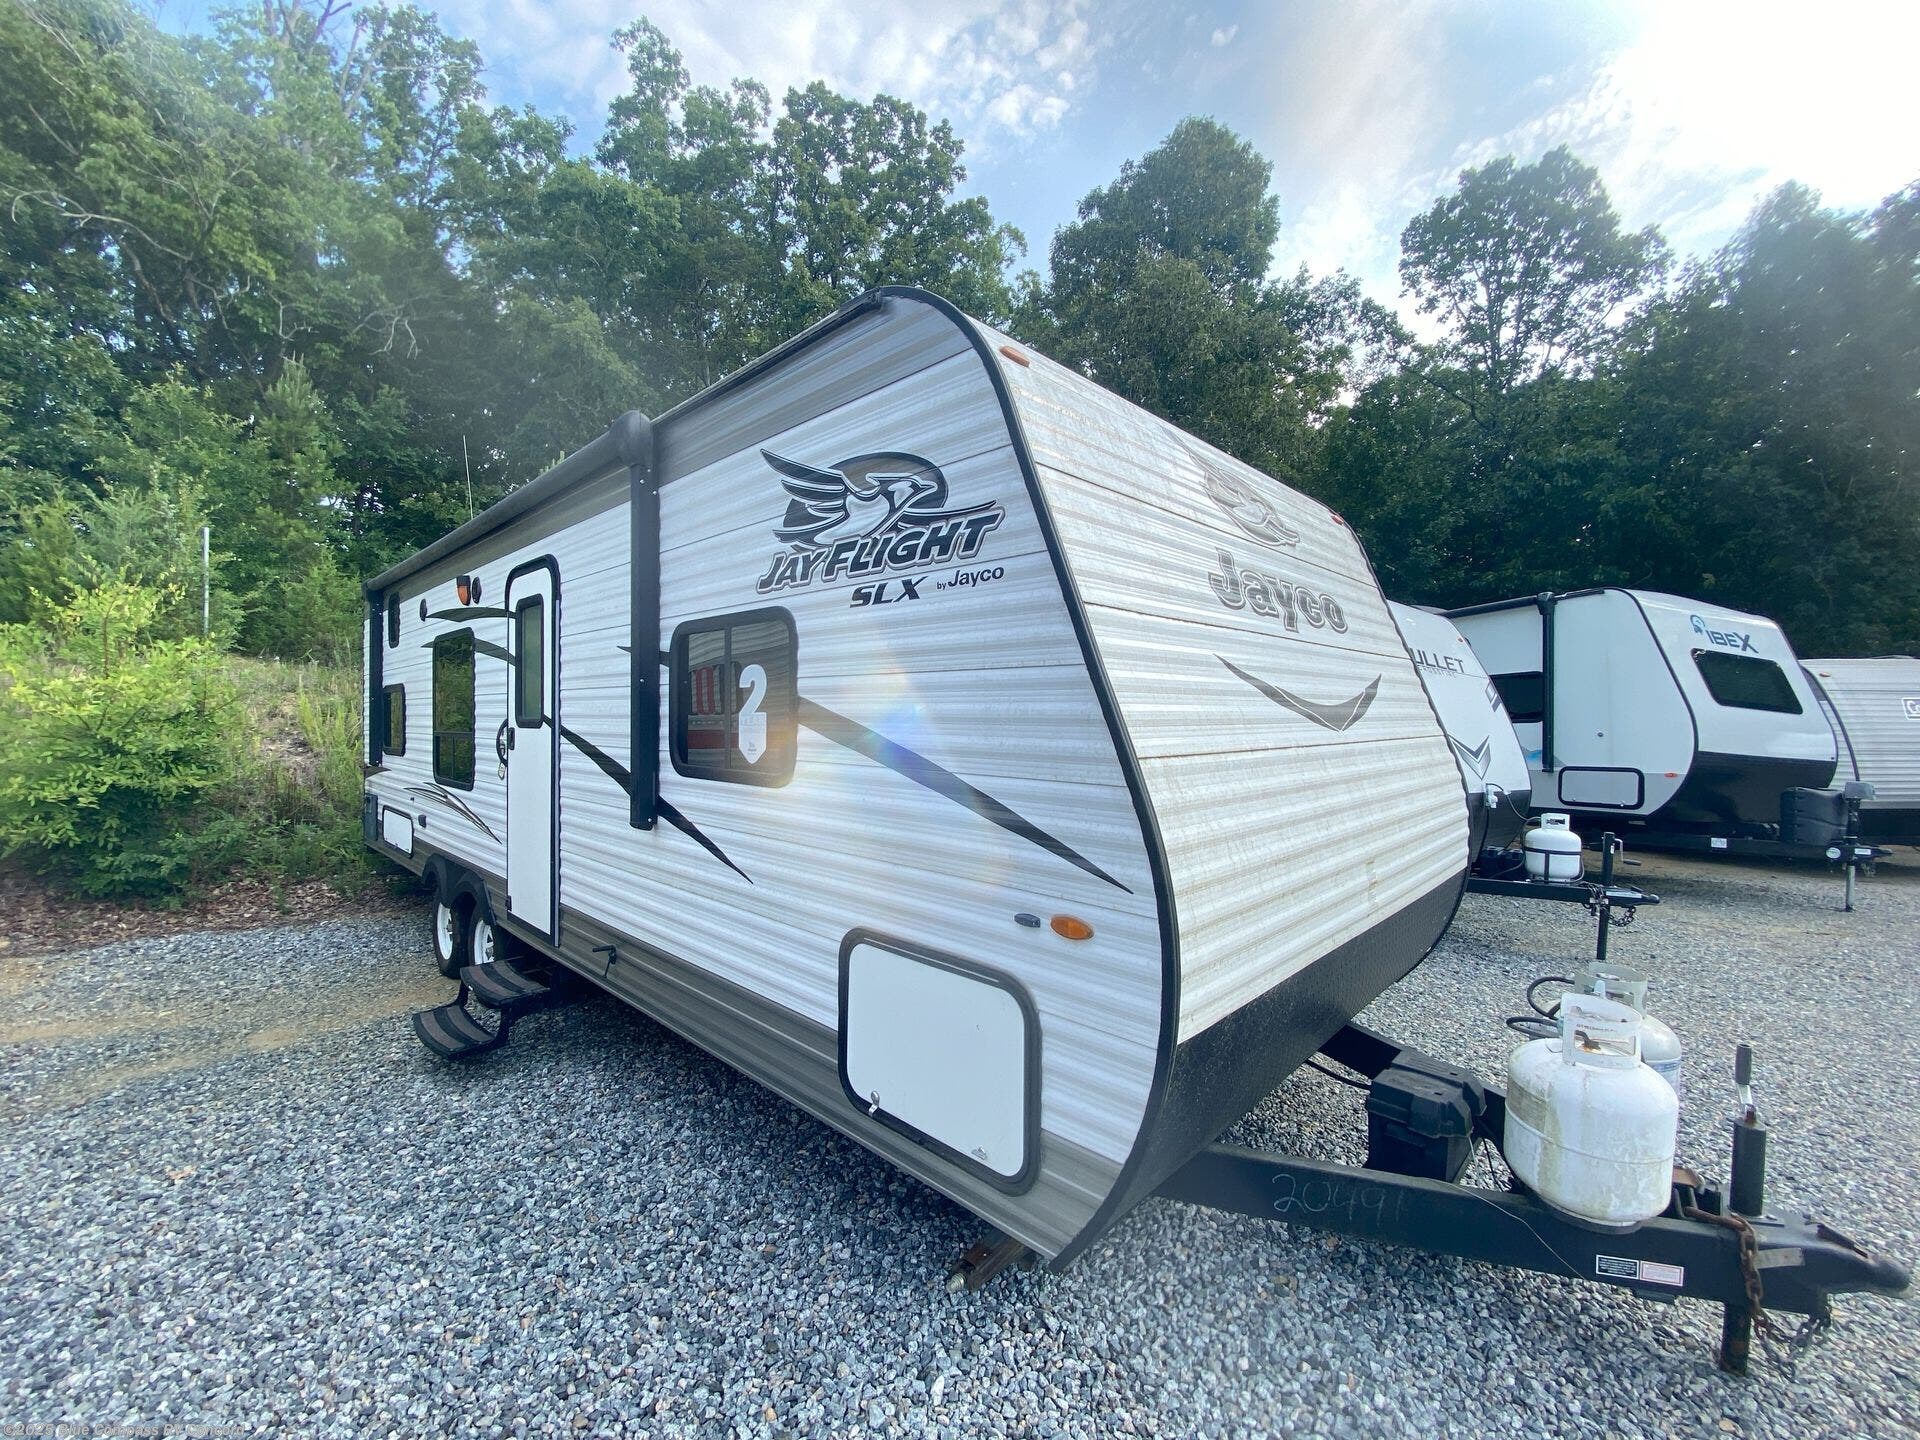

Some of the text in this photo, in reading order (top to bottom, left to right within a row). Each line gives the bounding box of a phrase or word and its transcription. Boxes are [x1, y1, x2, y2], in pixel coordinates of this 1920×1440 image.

[850, 575, 928, 608] SLX
[936, 566, 1005, 590] by Jayco
[1207, 546, 1348, 634] Jayco
[1705, 629, 1759, 654] IBEX
[738, 663, 768, 764] 2
[1271, 1173, 1405, 1228] 20491
